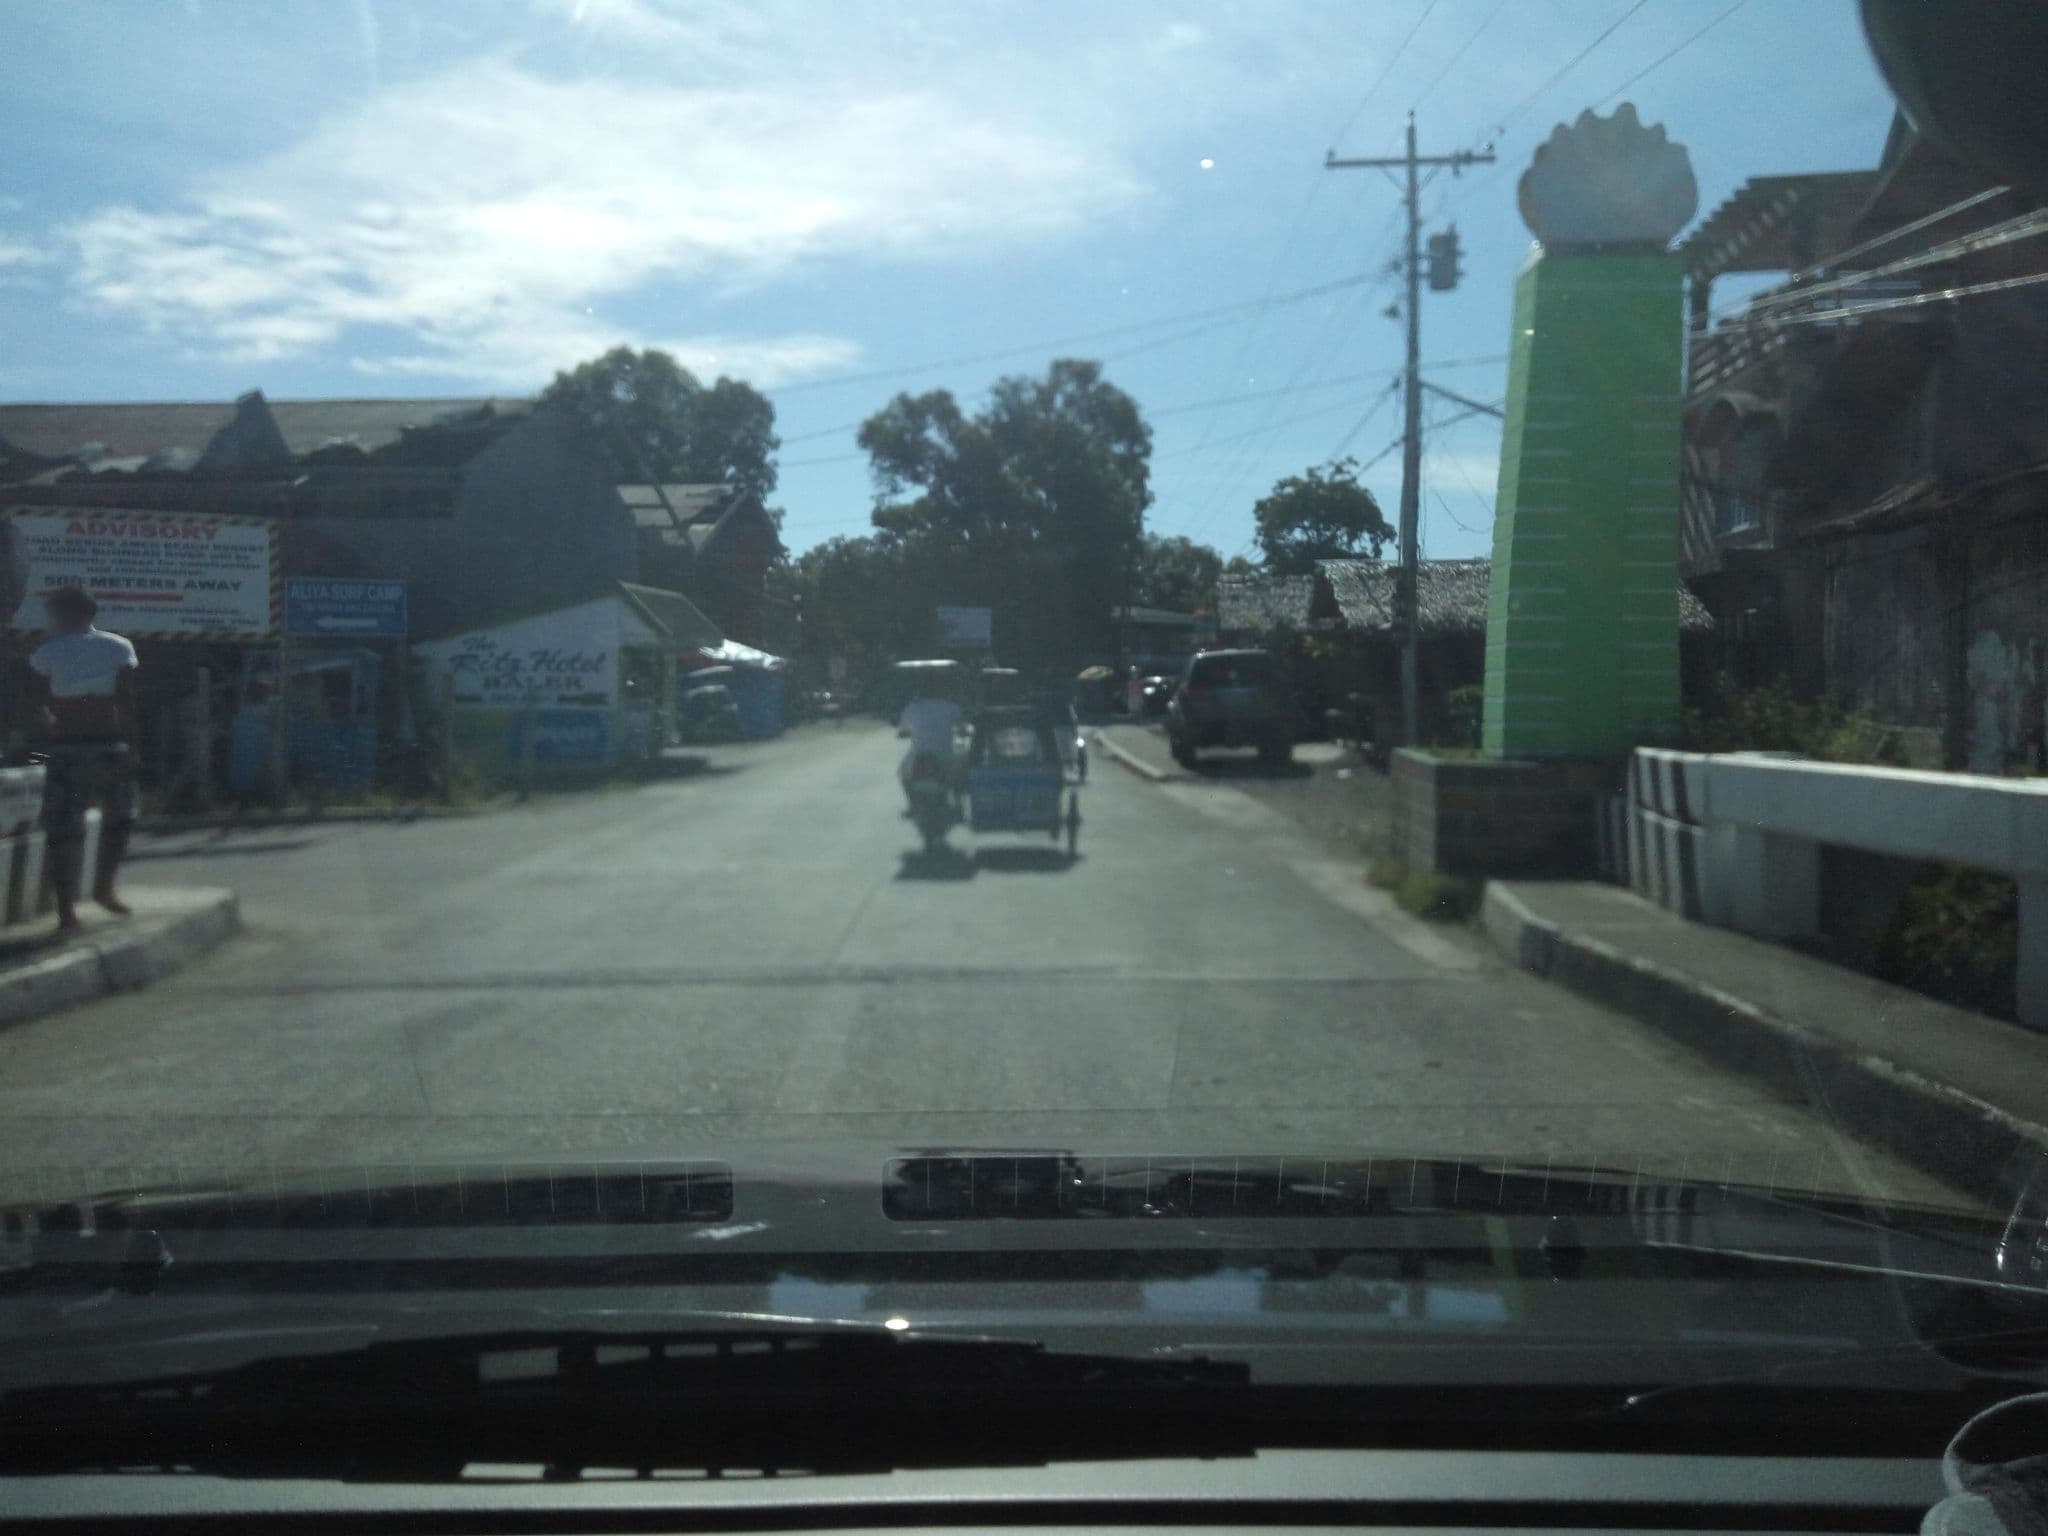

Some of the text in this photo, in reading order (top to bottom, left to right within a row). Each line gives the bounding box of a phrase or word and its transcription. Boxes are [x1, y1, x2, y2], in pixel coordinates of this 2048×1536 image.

[66, 519, 218, 539] ADVISORY
[90, 576, 176, 590] METERS
[184, 579, 242, 592] AWAY
[367, 585, 402, 602] CAMP
[529, 648, 607, 673] Hotel
[482, 674, 586, 690] BALER
